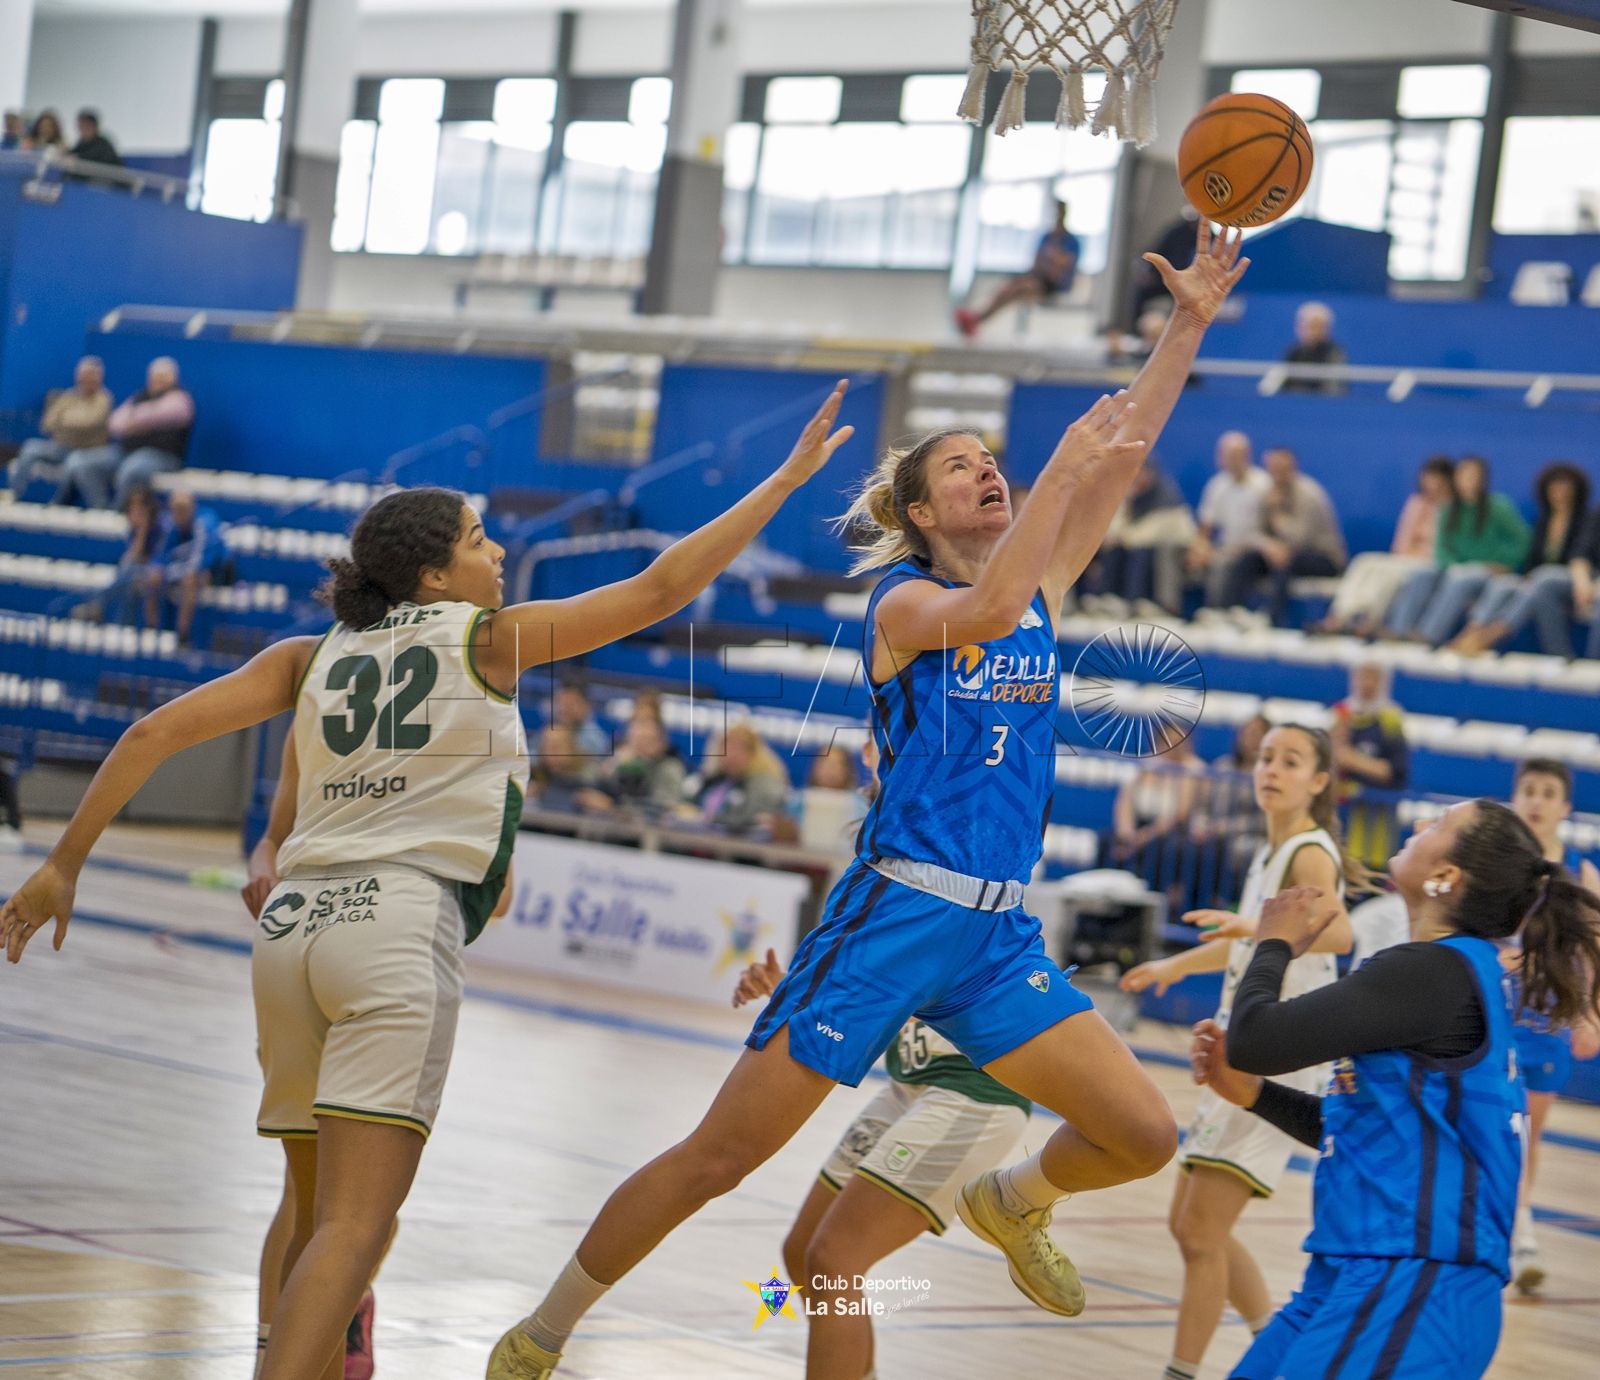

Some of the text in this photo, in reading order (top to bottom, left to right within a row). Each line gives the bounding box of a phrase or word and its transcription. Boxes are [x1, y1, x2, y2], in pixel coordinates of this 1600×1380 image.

[322, 645, 438, 757] 32
[947, 688, 978, 700] Ciudad
[984, 724, 1009, 767] 3
[341, 895, 379, 909] SOL
[303, 909, 376, 938] MLAGA
[815, 1021, 845, 1042] vive
